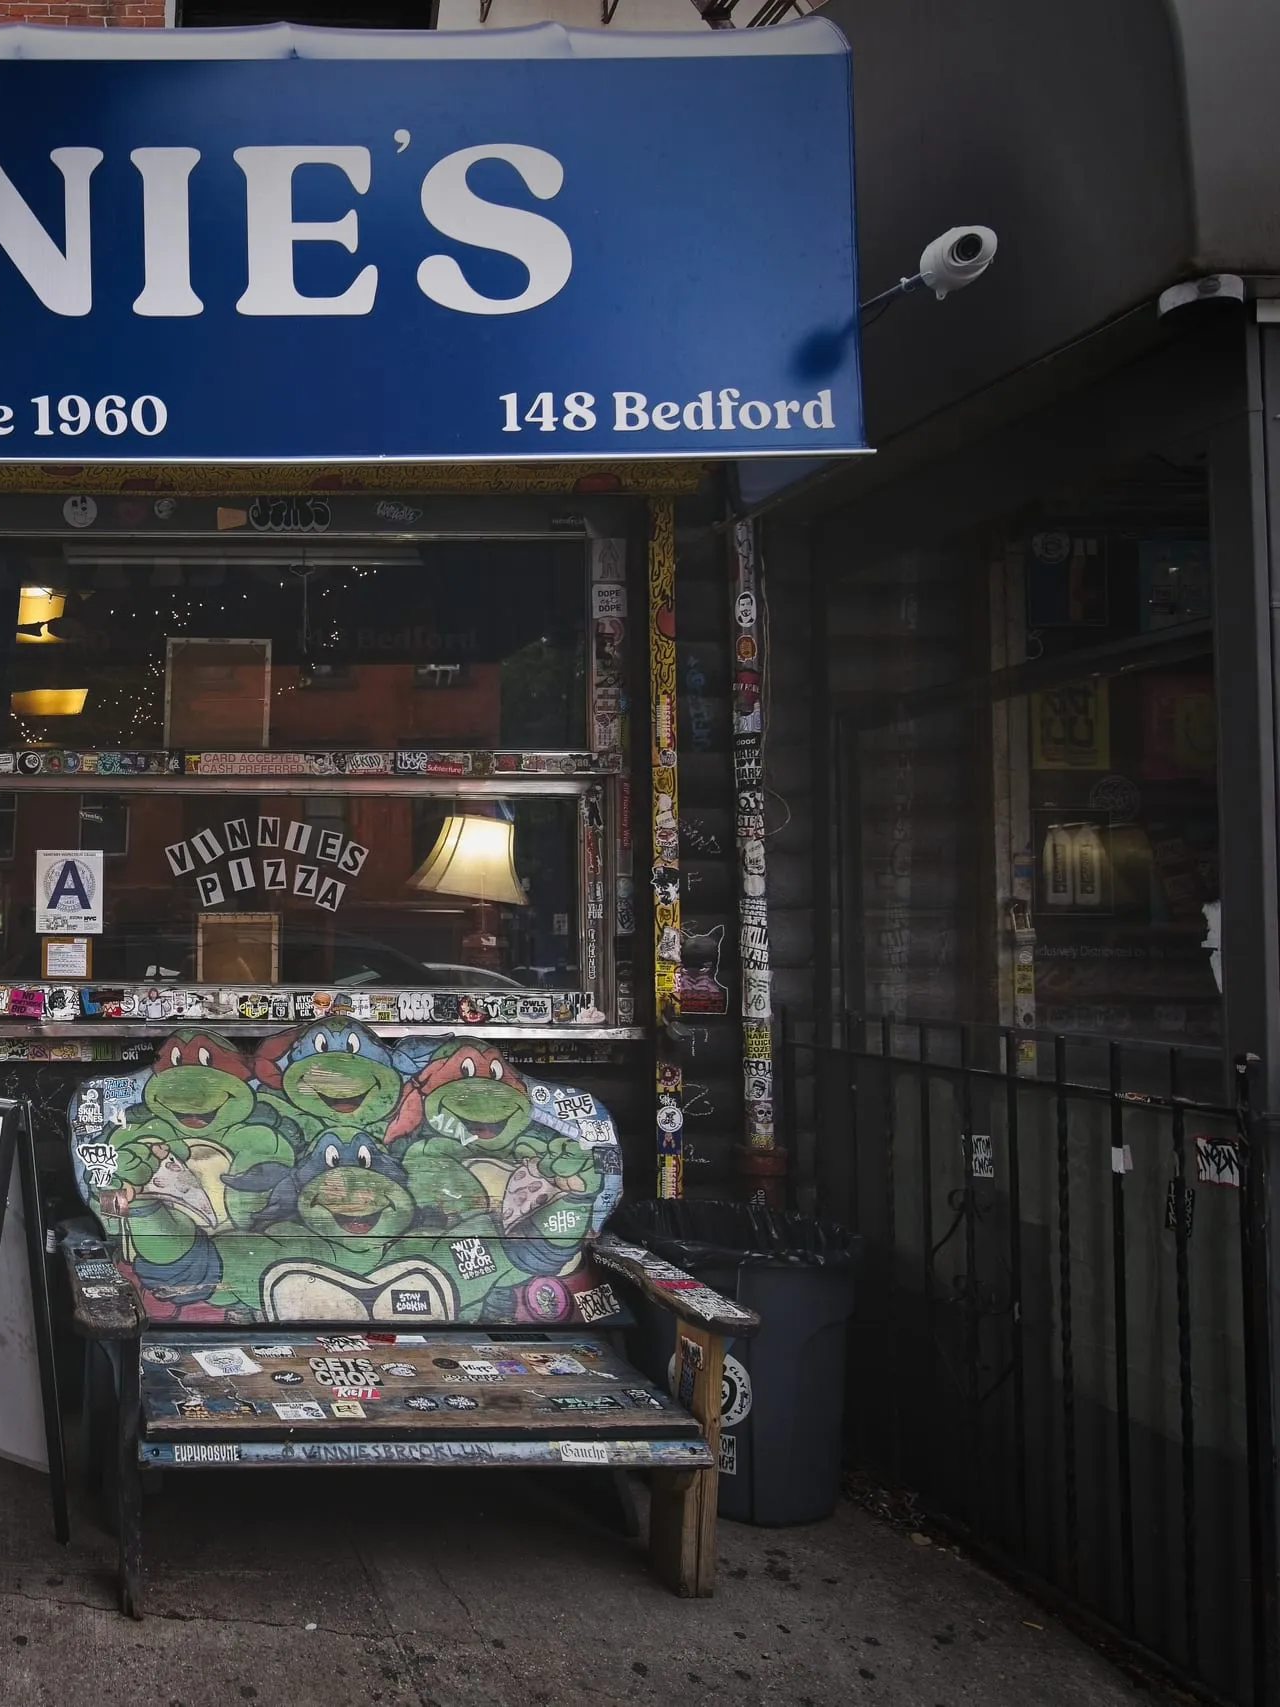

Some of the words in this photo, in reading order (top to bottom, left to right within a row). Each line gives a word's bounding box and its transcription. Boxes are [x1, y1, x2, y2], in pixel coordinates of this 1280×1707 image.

[31, 394, 168, 436] 1960
[501, 391, 596, 432] 148
[613, 388, 836, 432] Bedford
[204, 753, 236, 763] CARD
[239, 753, 301, 763] ACCEPTED
[202, 764, 233, 774] CASH
[238, 764, 305, 774] PREFERRED
[167, 818, 366, 873] VINNIES
[46, 860, 92, 910] A
[199, 860, 340, 910] PIZZA
[22, 991, 35, 1000] NO
[554, 1094, 591, 1110] TRUE
[557, 1105, 594, 1120] STV
[458, 1256, 494, 1272] COLOR
[398, 1293, 421, 1302] STAY
[308, 1357, 375, 1372] GETS
[314, 1371, 381, 1386] CHOP
[561, 1442, 607, 1461] Gauche
